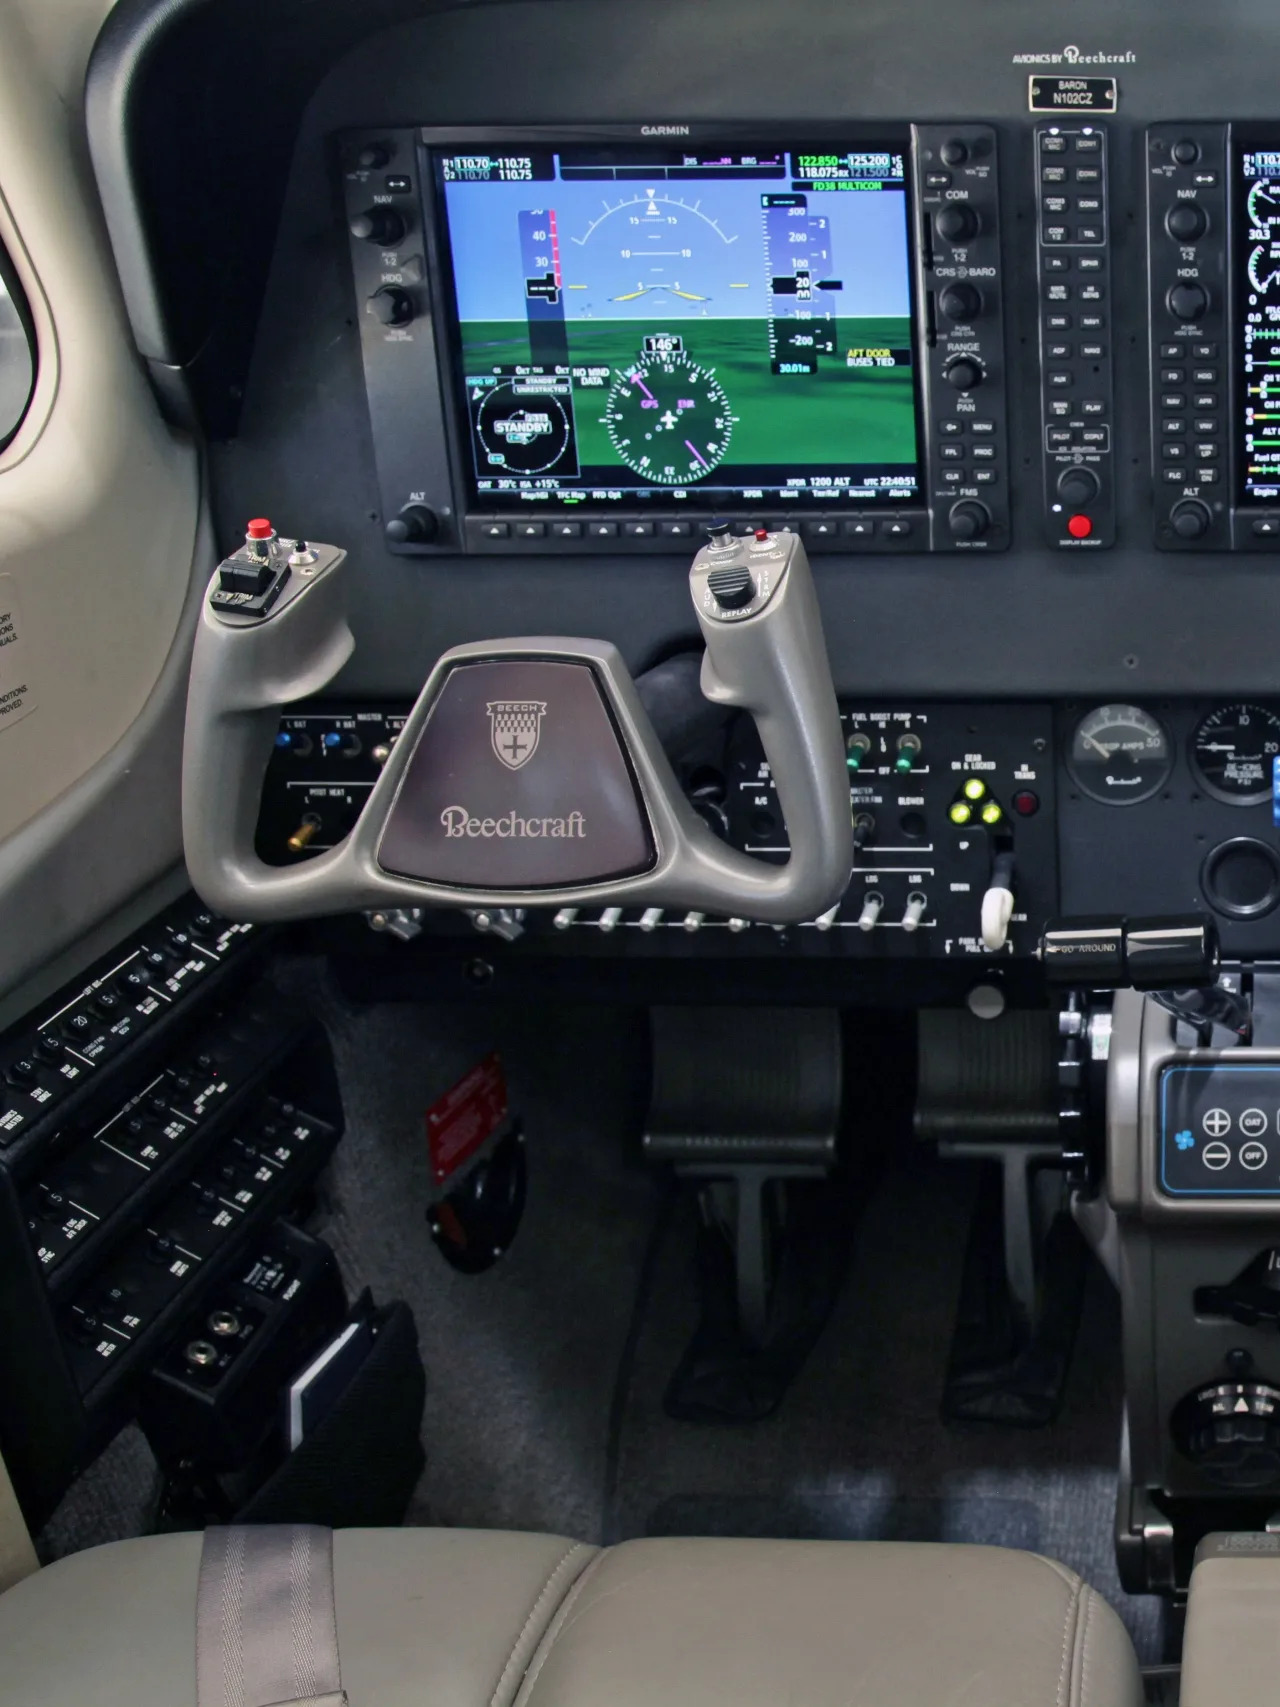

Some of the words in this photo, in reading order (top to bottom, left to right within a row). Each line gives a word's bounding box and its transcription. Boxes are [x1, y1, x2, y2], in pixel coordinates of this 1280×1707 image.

[1012, 54, 1050, 63] AVIONICS
[1052, 54, 1062, 63] BY
[1064, 45, 1136, 64] Beechcraft
[1059, 81, 1087, 90] BARON
[1053, 92, 1093, 104] N102CZ
[641, 126, 689, 135] GARMIN
[456, 157, 489, 169] 110.70
[498, 157, 531, 169] 110.75
[798, 156, 838, 167] 122.850
[850, 155, 888, 167] 125.200
[499, 169, 532, 180] 110.75
[813, 182, 836, 191] FD38
[838, 182, 882, 191] MULTICOM
[946, 191, 968, 199] COM
[1177, 190, 1197, 198] NAV
[374, 195, 392, 203] NAV
[532, 231, 546, 240] 40
[789, 232, 807, 242] 200
[1249, 229, 1270, 240] 30.3
[535, 257, 548, 267] 30
[792, 258, 808, 268] 100
[936, 268, 955, 276] CRS
[969, 268, 996, 276] BARO
[1177, 269, 1198, 277] HDG
[381, 274, 403, 283] HDG
[947, 343, 980, 351] RANGE
[848, 349, 864, 357] AFT
[866, 349, 890, 357] DOOR
[847, 357, 873, 366] BUSES
[876, 357, 895, 366] TIED
[573, 368, 587, 377] NO
[589, 368, 610, 377] WIND
[581, 377, 603, 386] DATA
[957, 404, 975, 412] PAN
[496, 422, 550, 433] STANDBY
[810, 477, 831, 486] 1200
[834, 477, 850, 486] ALT
[864, 478, 879, 486] UTC
[880, 477, 915, 486] 22:40:51
[1254, 489, 1277, 497] Engine
[721, 608, 752, 619] REPLAY
[497, 704, 538, 712] BEECH
[357, 713, 382, 721] MASTER
[852, 713, 867, 721] FUEL
[870, 713, 890, 721] BOOST
[893, 713, 912, 721] PUMP
[1239, 715, 1249, 725] 10
[1265, 743, 1278, 753] 20
[965, 754, 982, 762] GEAR
[971, 761, 996, 770] LOCKED
[1014, 771, 1036, 780] TRANS
[1224, 770, 1264, 779] PRESSURE
[441, 806, 587, 838] Beechcraft
[959, 841, 970, 850] UP
[1061, 945, 1074, 953] GO
[1078, 943, 1116, 952] AROUND
[73, 1015, 88, 1027] 20
[1245, 1118, 1262, 1127] OAT
[1245, 1151, 1262, 1160] OFF
